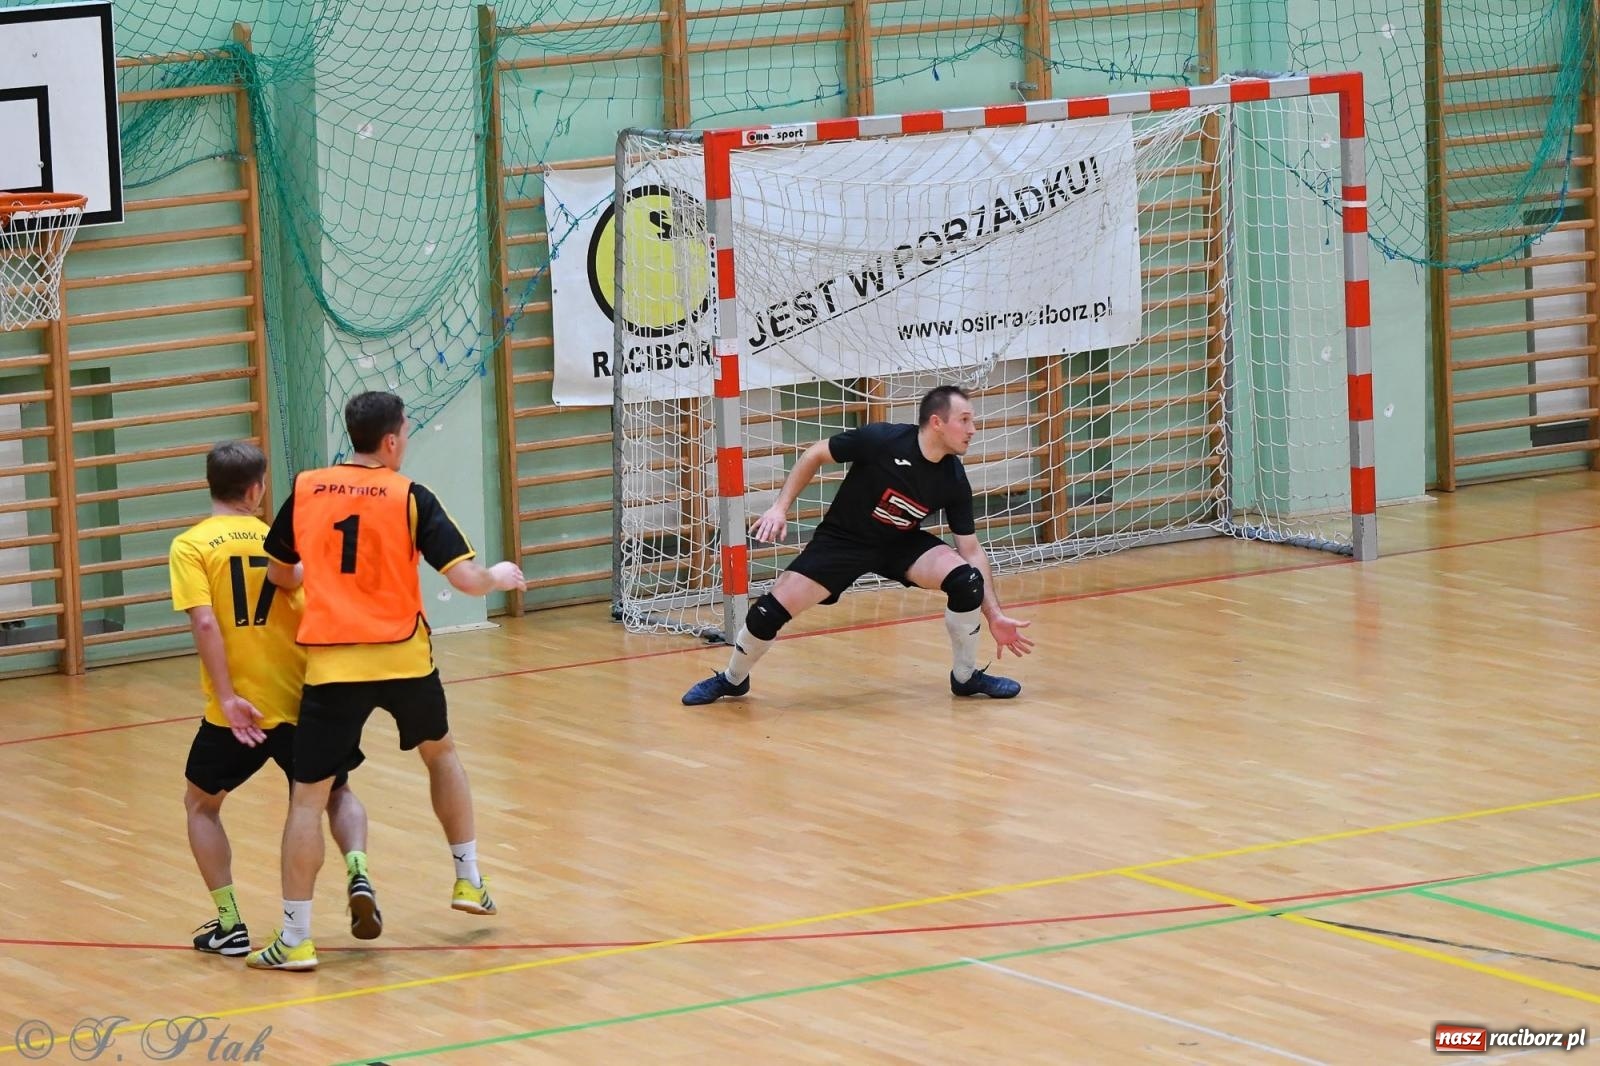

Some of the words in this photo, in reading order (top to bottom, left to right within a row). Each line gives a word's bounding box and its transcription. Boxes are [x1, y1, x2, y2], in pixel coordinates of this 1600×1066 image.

[776, 128, 804, 141] sport
[748, 277, 837, 348] JEST
[847, 256, 885, 297] W
[329, 484, 388, 497] PATRICK
[333, 514, 360, 574] 1
[229, 555, 277, 628] 17
